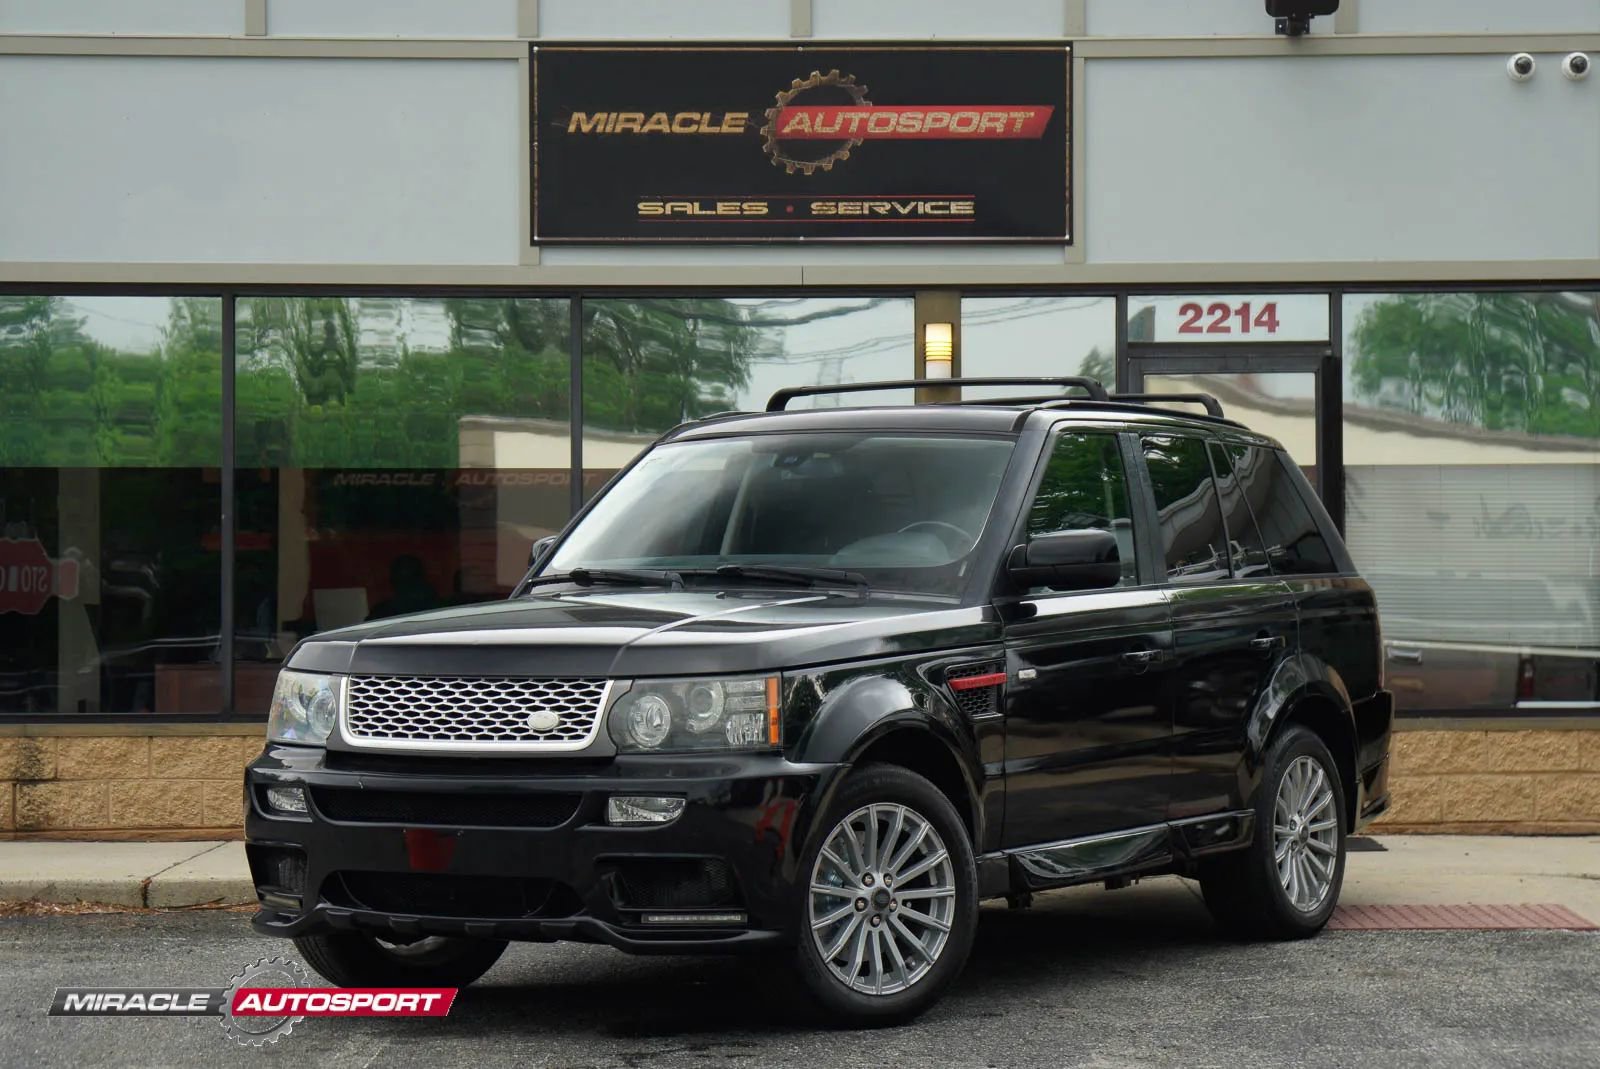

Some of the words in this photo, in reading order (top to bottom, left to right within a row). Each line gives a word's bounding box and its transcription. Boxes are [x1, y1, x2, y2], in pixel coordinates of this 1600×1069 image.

[567, 111, 749, 134] MIRACLE
[781, 111, 1035, 134] AUTOSPORT
[637, 200, 769, 215] SALES
[810, 200, 975, 215] SERVICE
[1178, 302, 1280, 334] 2214
[333, 472, 437, 487] MIRACLE
